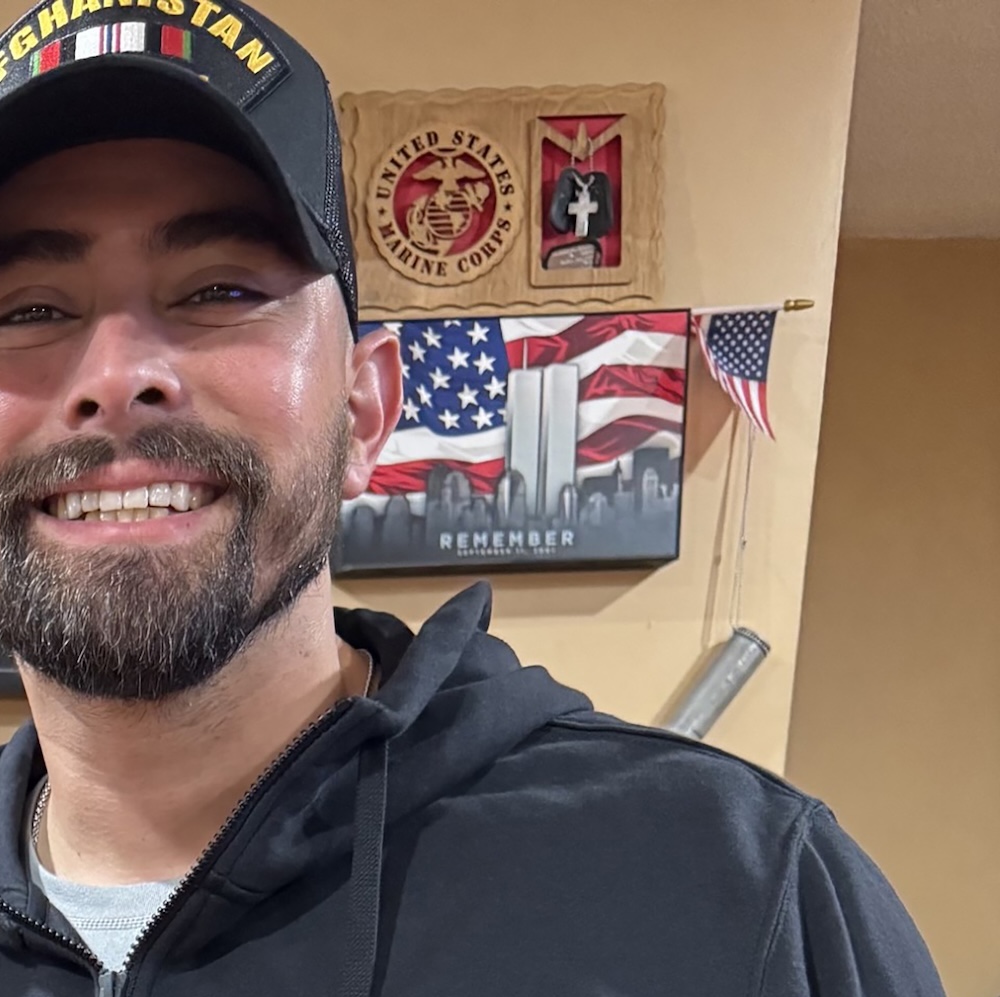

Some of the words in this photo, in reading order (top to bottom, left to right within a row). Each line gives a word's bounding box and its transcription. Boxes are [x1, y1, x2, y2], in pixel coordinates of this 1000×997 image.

[376, 130, 440, 200] UNITED
[451, 130, 516, 203] STATES
[378, 221, 448, 277] MARINE
[457, 217, 512, 274] CORPS
[440, 529, 575, 550] REMEMBER
